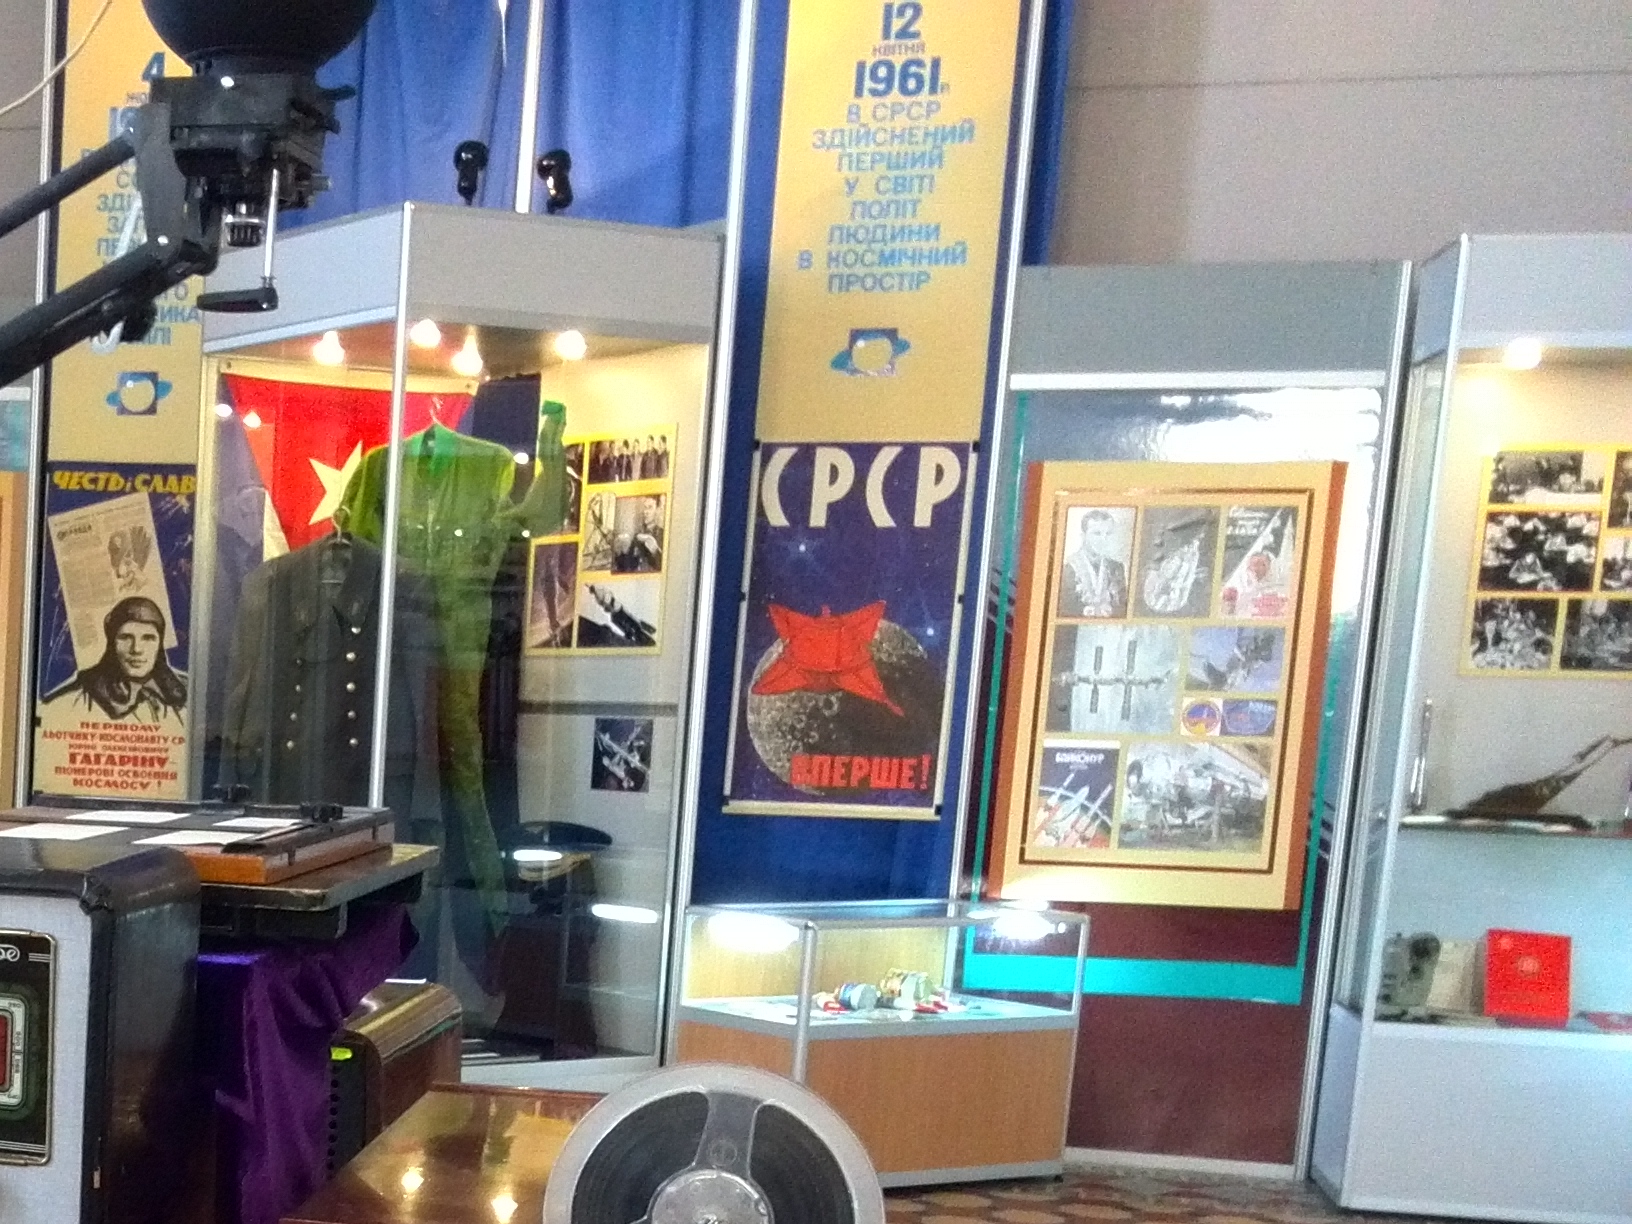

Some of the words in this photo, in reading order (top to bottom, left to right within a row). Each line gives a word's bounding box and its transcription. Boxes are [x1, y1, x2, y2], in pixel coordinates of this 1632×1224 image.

[882, 2, 923, 41] 12
[847, 103, 861, 124] В
[872, 100, 941, 122] СРСР
[813, 118, 976, 150] ЗДІЙСНЕНИЙ
[837, 147, 944, 172] ПЕРШИЙ
[875, 173, 935, 195] СВІТІ
[850, 199, 921, 220] ПОЛІТ
[828, 223, 941, 246] ЛЮДИНИ
[828, 270, 931, 293] ПРОСТІР
[53, 470, 125, 492] ЧЕСТЬ
[134, 472, 196, 494] СЛАВ
[761, 445, 962, 528] СРСР
[791, 753, 932, 790] ВПЕРШЕ!
